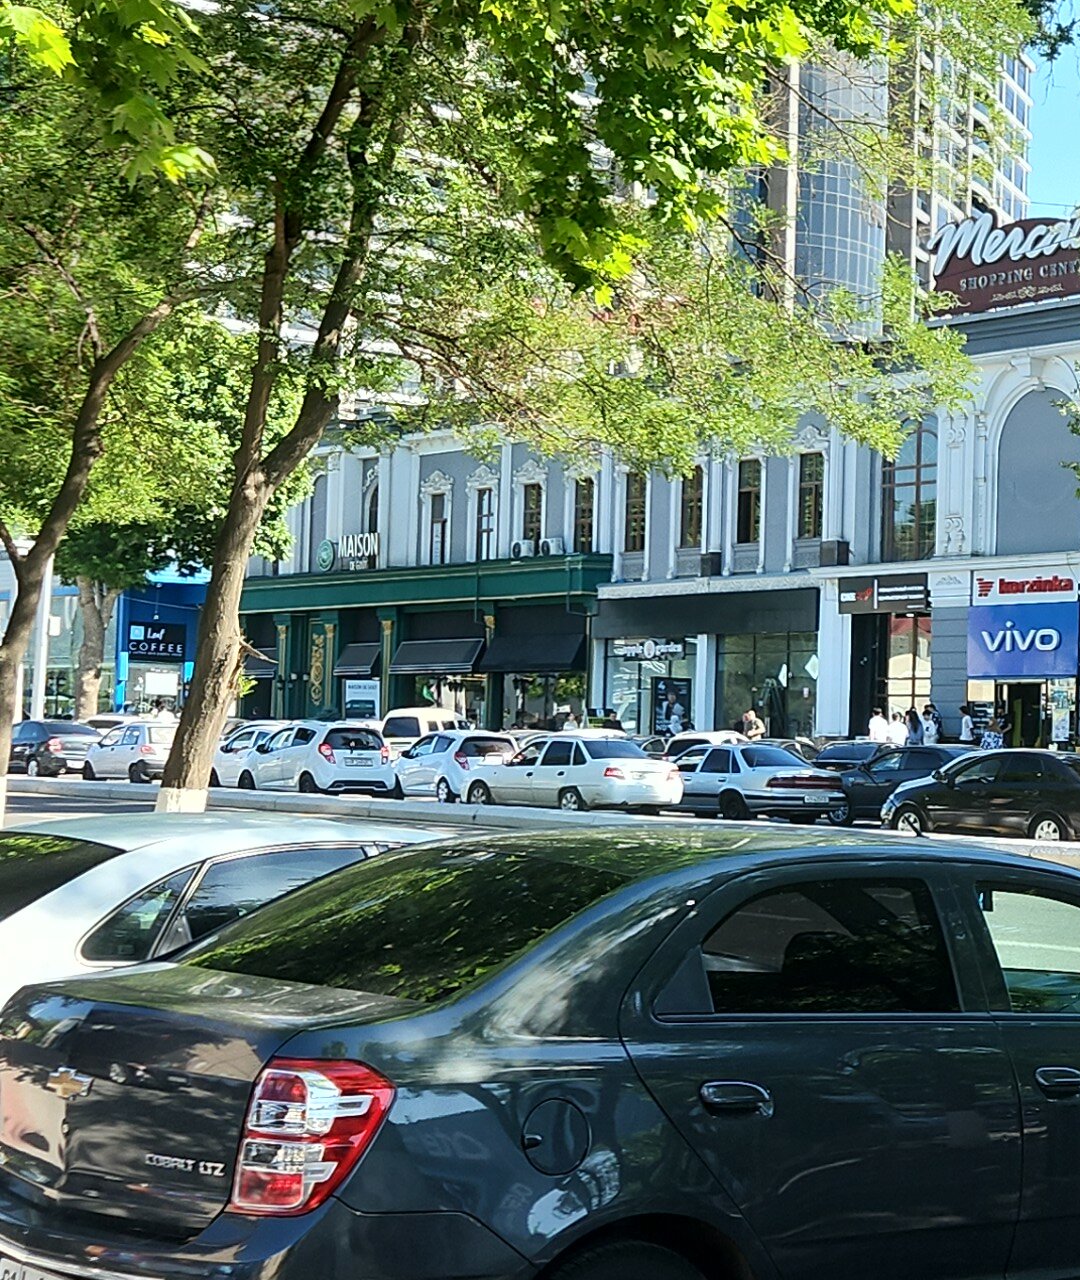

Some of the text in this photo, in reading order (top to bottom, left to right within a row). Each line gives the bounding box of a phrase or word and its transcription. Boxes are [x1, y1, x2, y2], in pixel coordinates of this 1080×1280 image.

[959, 267, 1033, 291] SHOPPING
[338, 532, 379, 558] MAISON
[999, 576, 1073, 594] korzinka
[129, 641, 183, 653] COFFEE
[982, 621, 1060, 652] vivo
[145, 1153, 225, 1177] COBALT LTZ
